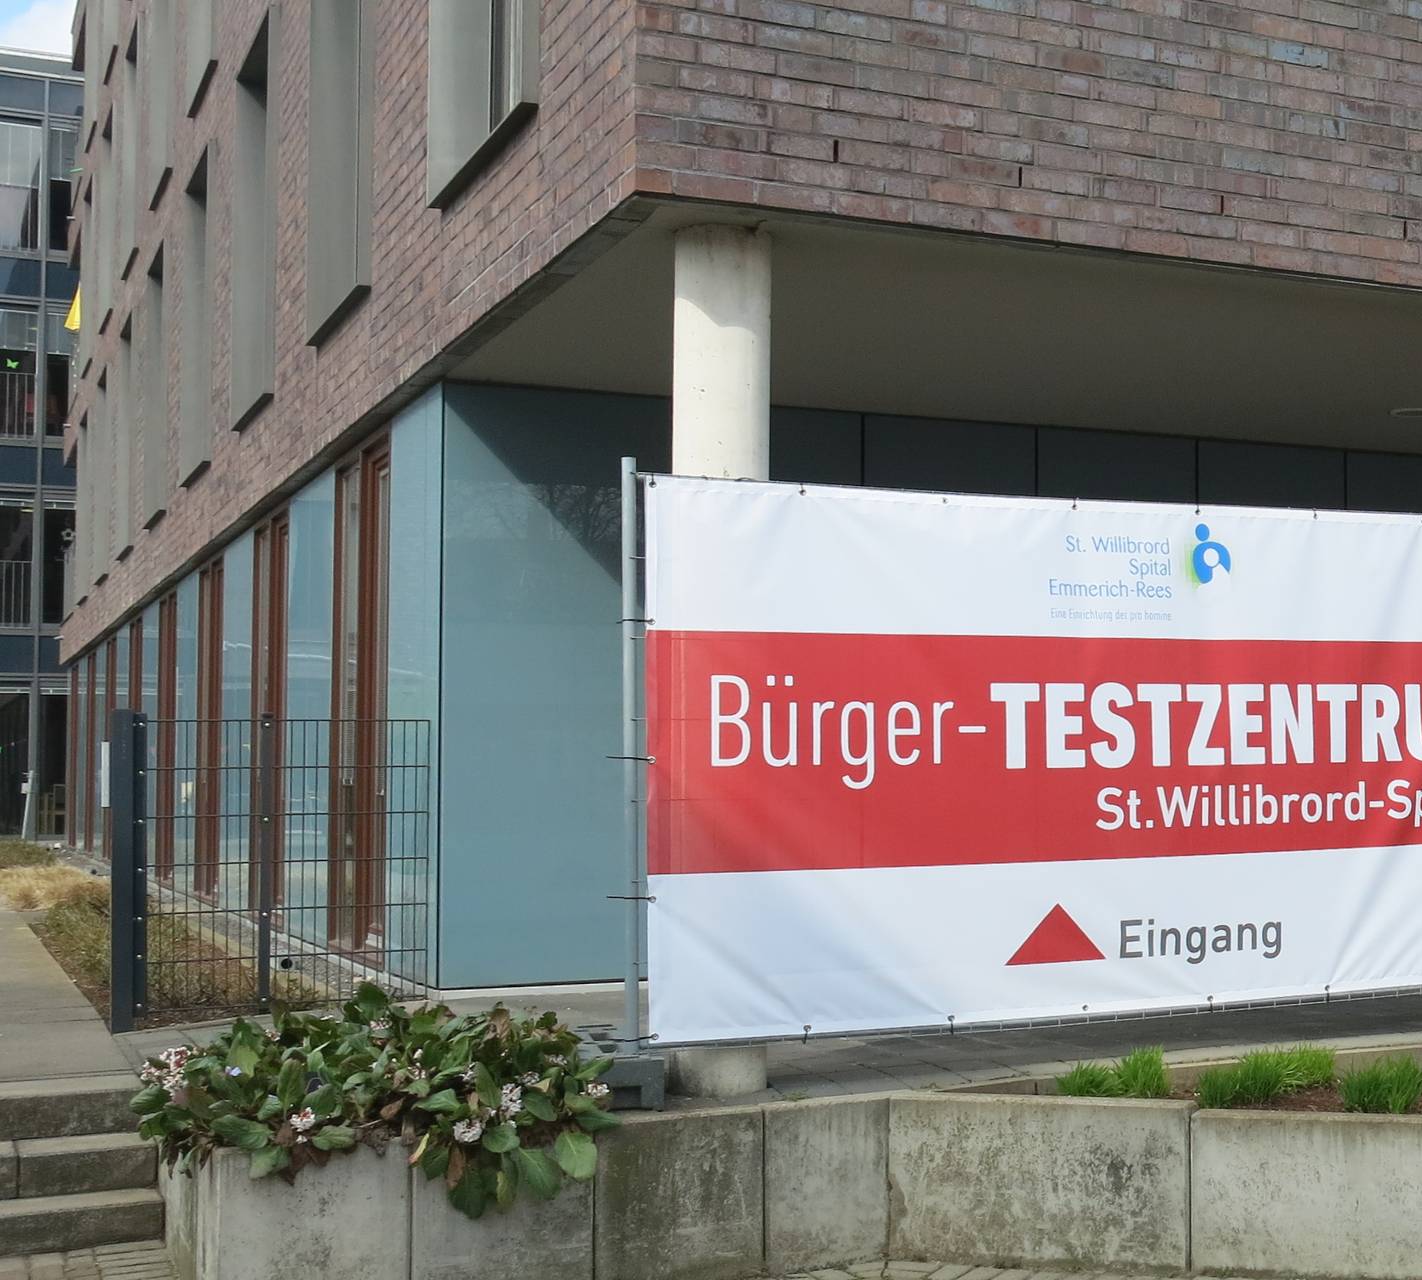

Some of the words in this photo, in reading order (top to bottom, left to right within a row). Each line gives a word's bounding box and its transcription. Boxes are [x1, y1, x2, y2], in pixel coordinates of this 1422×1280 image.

[1065, 535, 1087, 553] St.
[1091, 535, 1170, 554] Willibrord
[1129, 558, 1172, 579] Spital
[1049, 579, 1173, 599] Emmerich-Rees
[1050, 608, 1067, 619] Eine
[1068, 608, 1113, 622] Einrichtung
[1119, 918, 1282, 965] Eingang
